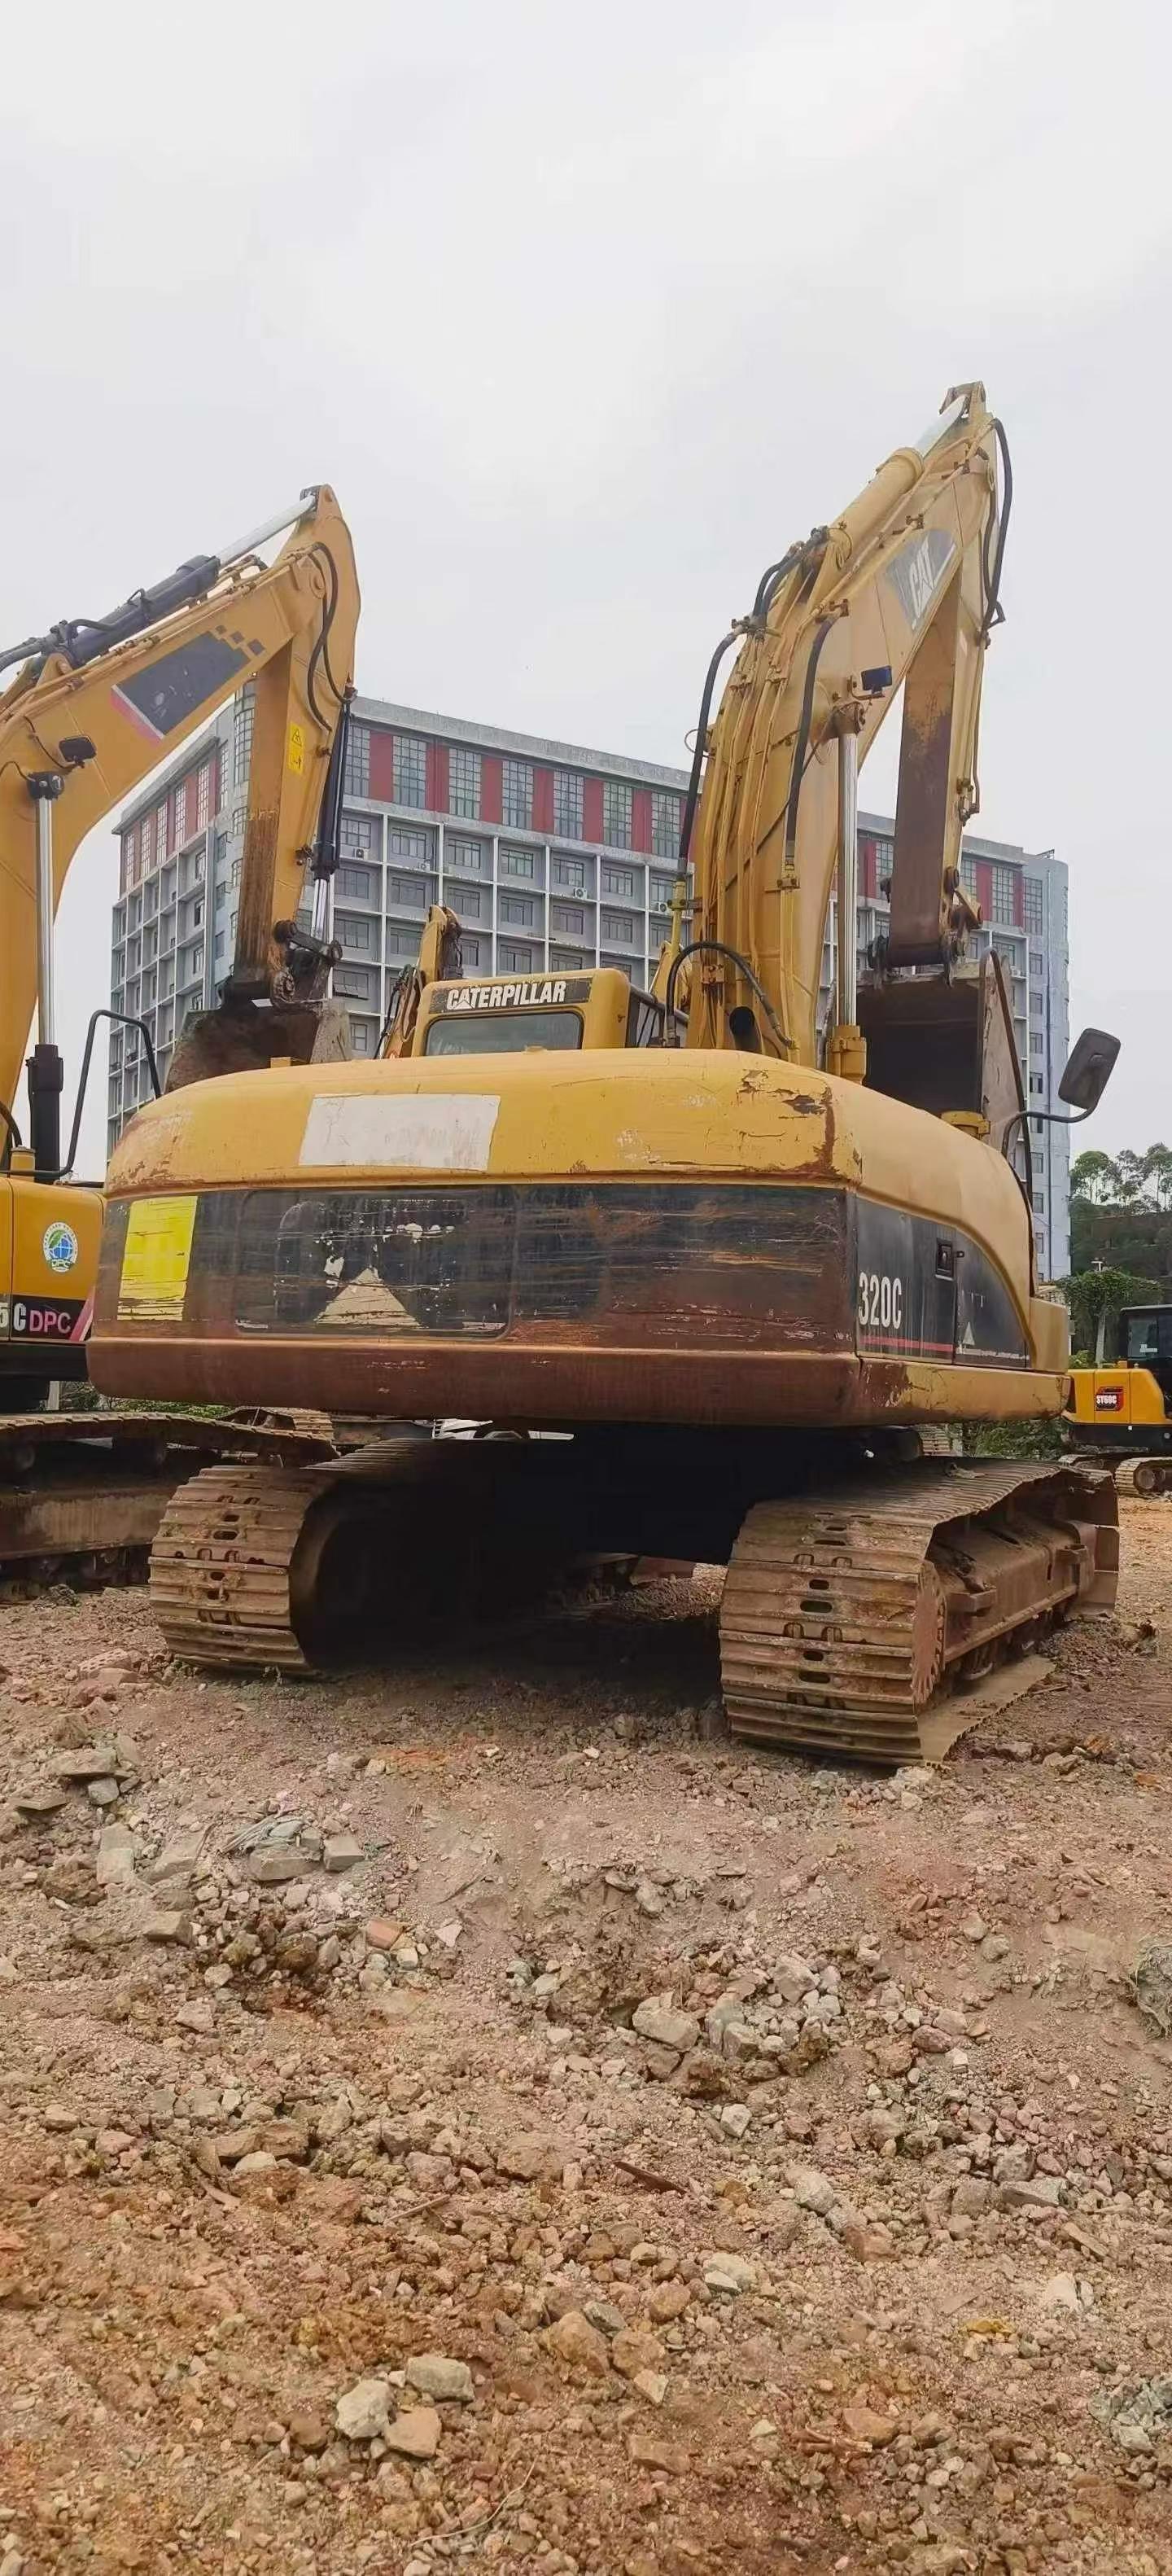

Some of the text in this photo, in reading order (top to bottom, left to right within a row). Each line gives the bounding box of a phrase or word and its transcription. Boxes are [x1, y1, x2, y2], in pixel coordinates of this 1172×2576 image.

[909, 532, 936, 618] CAT
[446, 980, 567, 1010] CATERPILLAR
[29, 1309, 72, 1334] DPC
[858, 1272, 902, 1330] 320C
